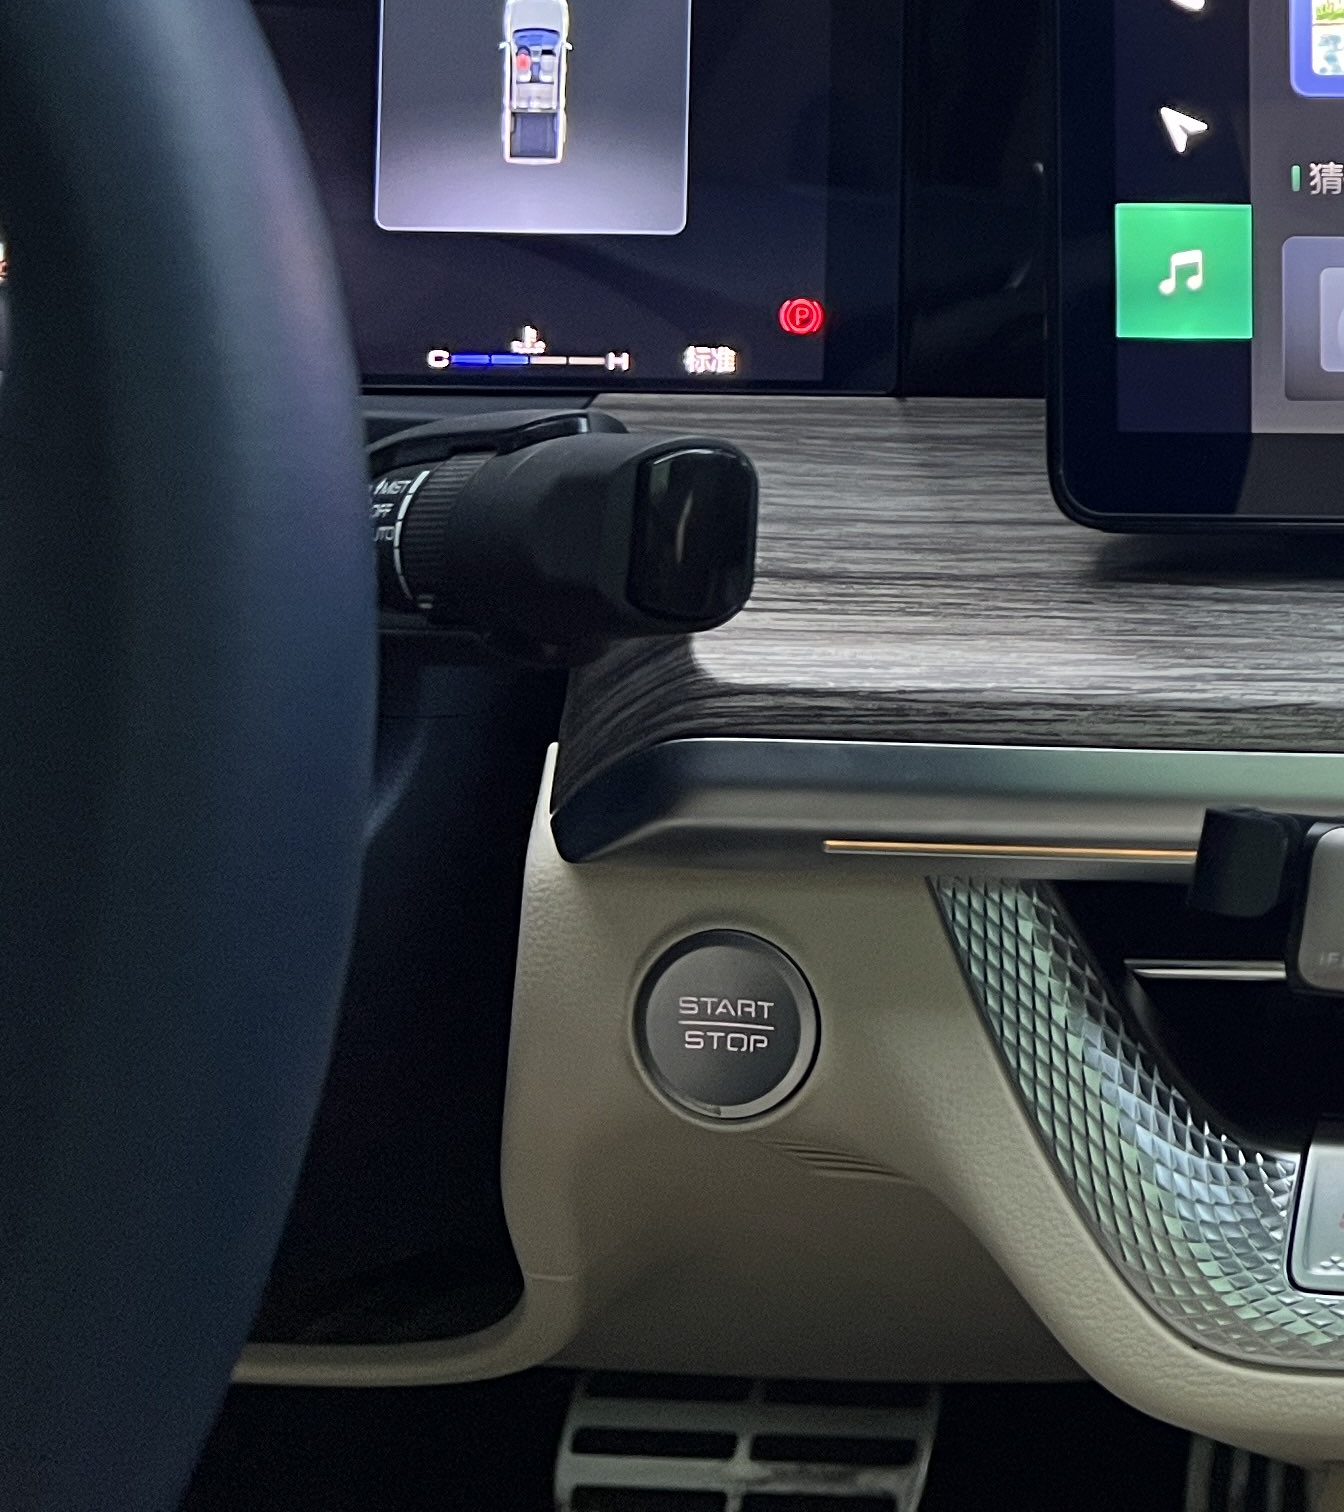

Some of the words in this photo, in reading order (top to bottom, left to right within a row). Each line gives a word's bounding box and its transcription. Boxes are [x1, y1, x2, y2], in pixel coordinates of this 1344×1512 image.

[427, 348, 450, 368] C
[605, 351, 630, 371] H
[678, 996, 775, 1019] START
[684, 1030, 768, 1053] STOP
